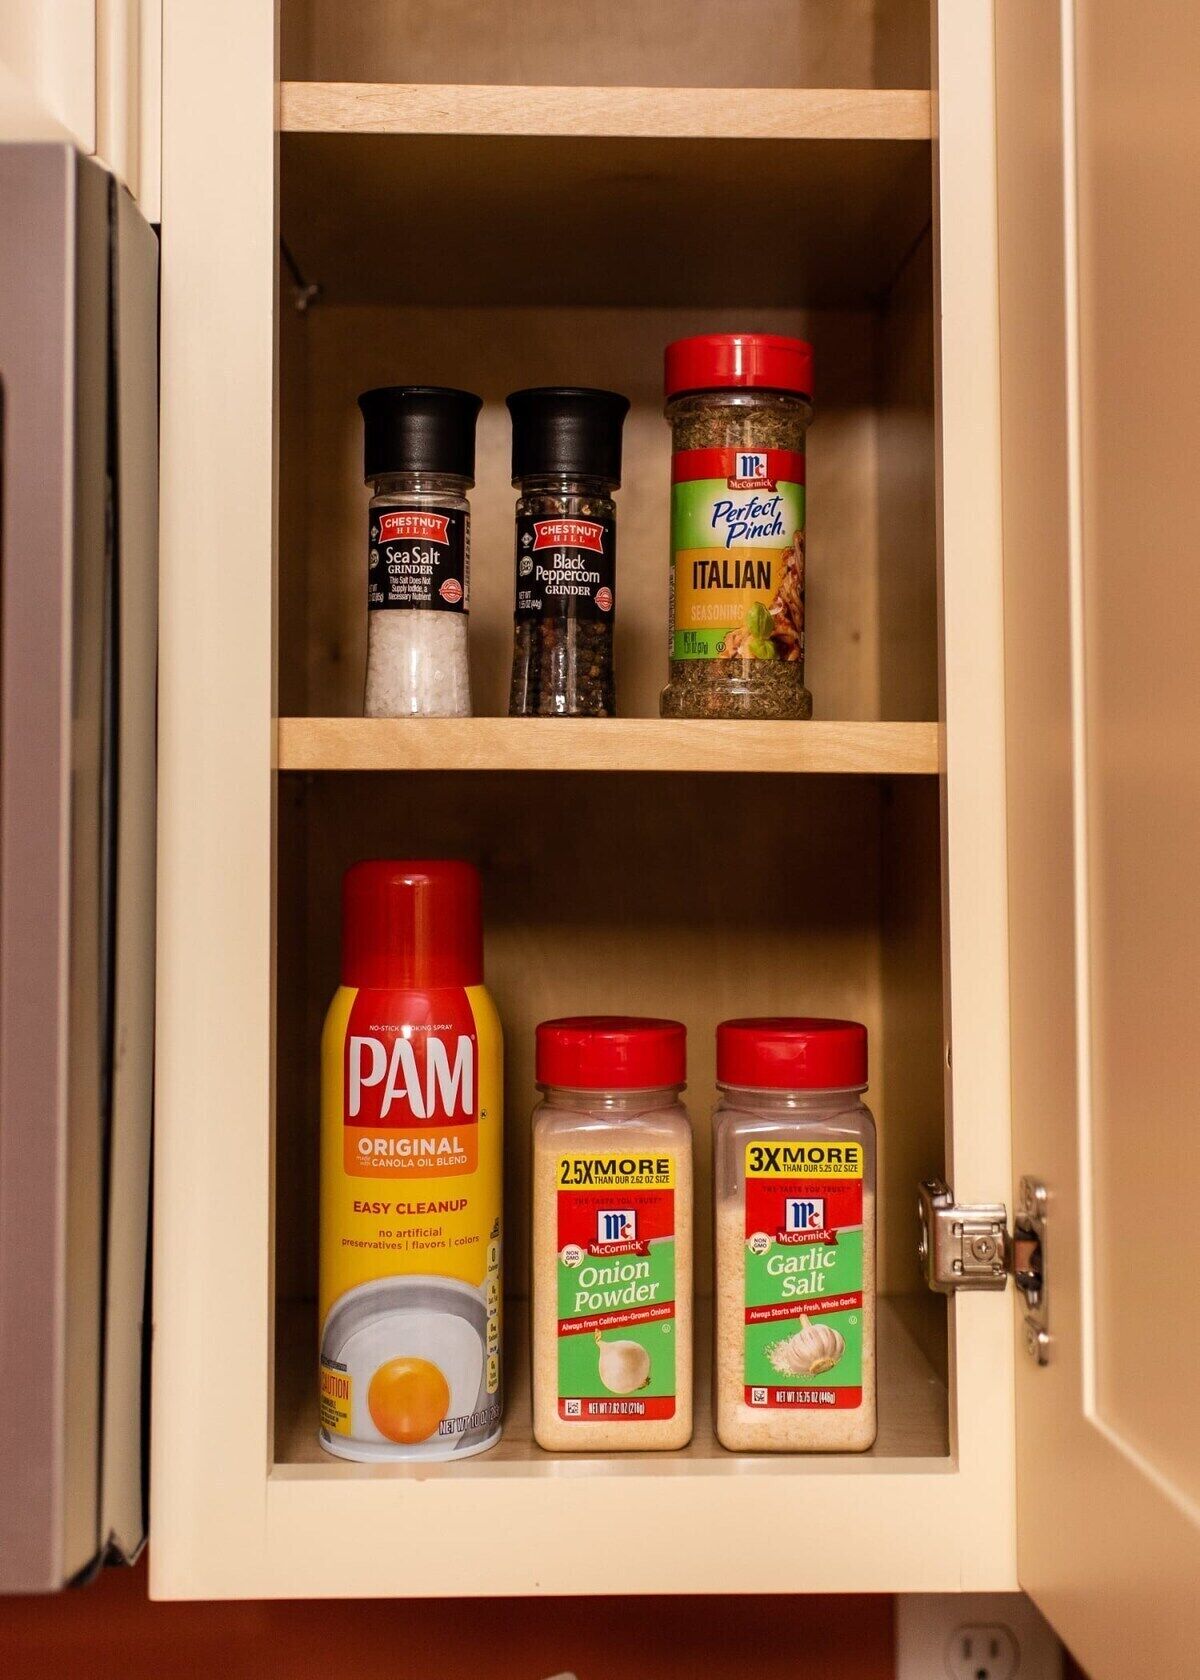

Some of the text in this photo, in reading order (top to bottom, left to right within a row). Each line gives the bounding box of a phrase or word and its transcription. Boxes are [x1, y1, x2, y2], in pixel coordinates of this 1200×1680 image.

[730, 479, 772, 489] McCormick
[712, 496, 783, 528] Perfect
[385, 516, 442, 530] CHESTNUT
[397, 527, 428, 535] HILL
[540, 524, 598, 538] CHESTNUT
[726, 512, 783, 548] Pinch
[554, 534, 585, 543] HILL
[386, 547, 440, 564] Sea Salt
[554, 554, 586, 570] Black
[388, 564, 433, 574] GRINDER
[693, 560, 771, 590] ITALIAN
[392, 584, 407, 593] Supply
[400, 576, 408, 584] Salt
[409, 576, 421, 584] Does
[422, 576, 431, 585] Not
[545, 585, 590, 596] GRINDER
[692, 604, 743, 621] SEASONING
[350, 1035, 474, 1118] PAM
[358, 1136, 464, 1156] ORIGINAL
[372, 1155, 467, 1167] CANOLA OIL BLEND
[750, 1147, 858, 1172] 3X MORE
[561, 1159, 670, 1184] 2.5X MORE
[783, 1164, 858, 1172] THAN OUR 5.25 OZ SIZE
[595, 1175, 670, 1184] THAN OUR 2.62 OZ SIZE
[353, 1199, 468, 1215] EASY CLEANUP
[379, 1227, 442, 1238] no artificial
[778, 1230, 832, 1243] McCormick
[342, 1234, 480, 1250] preservatives flavors colors
[590, 1241, 643, 1254] McCormick
[767, 1247, 836, 1275] Garlic
[579, 1261, 650, 1288] Onion
[782, 1272, 825, 1297] Salt
[574, 1281, 660, 1312] Powder
[750, 1311, 770, 1319] Always
[821, 1300, 839, 1309] Whole
[840, 1297, 856, 1306] Garlic
[562, 1307, 671, 1331] Always from California-Grown Onions
[776, 1391, 785, 1402] NET
[787, 1391, 795, 1402] WT
[811, 1391, 818, 1402] OZ
[588, 1402, 598, 1414] NET
[600, 1402, 607, 1414] WT
[620, 1402, 627, 1414] OZ
[439, 1418, 455, 1435] NET
[457, 1416, 469, 1432] WT
